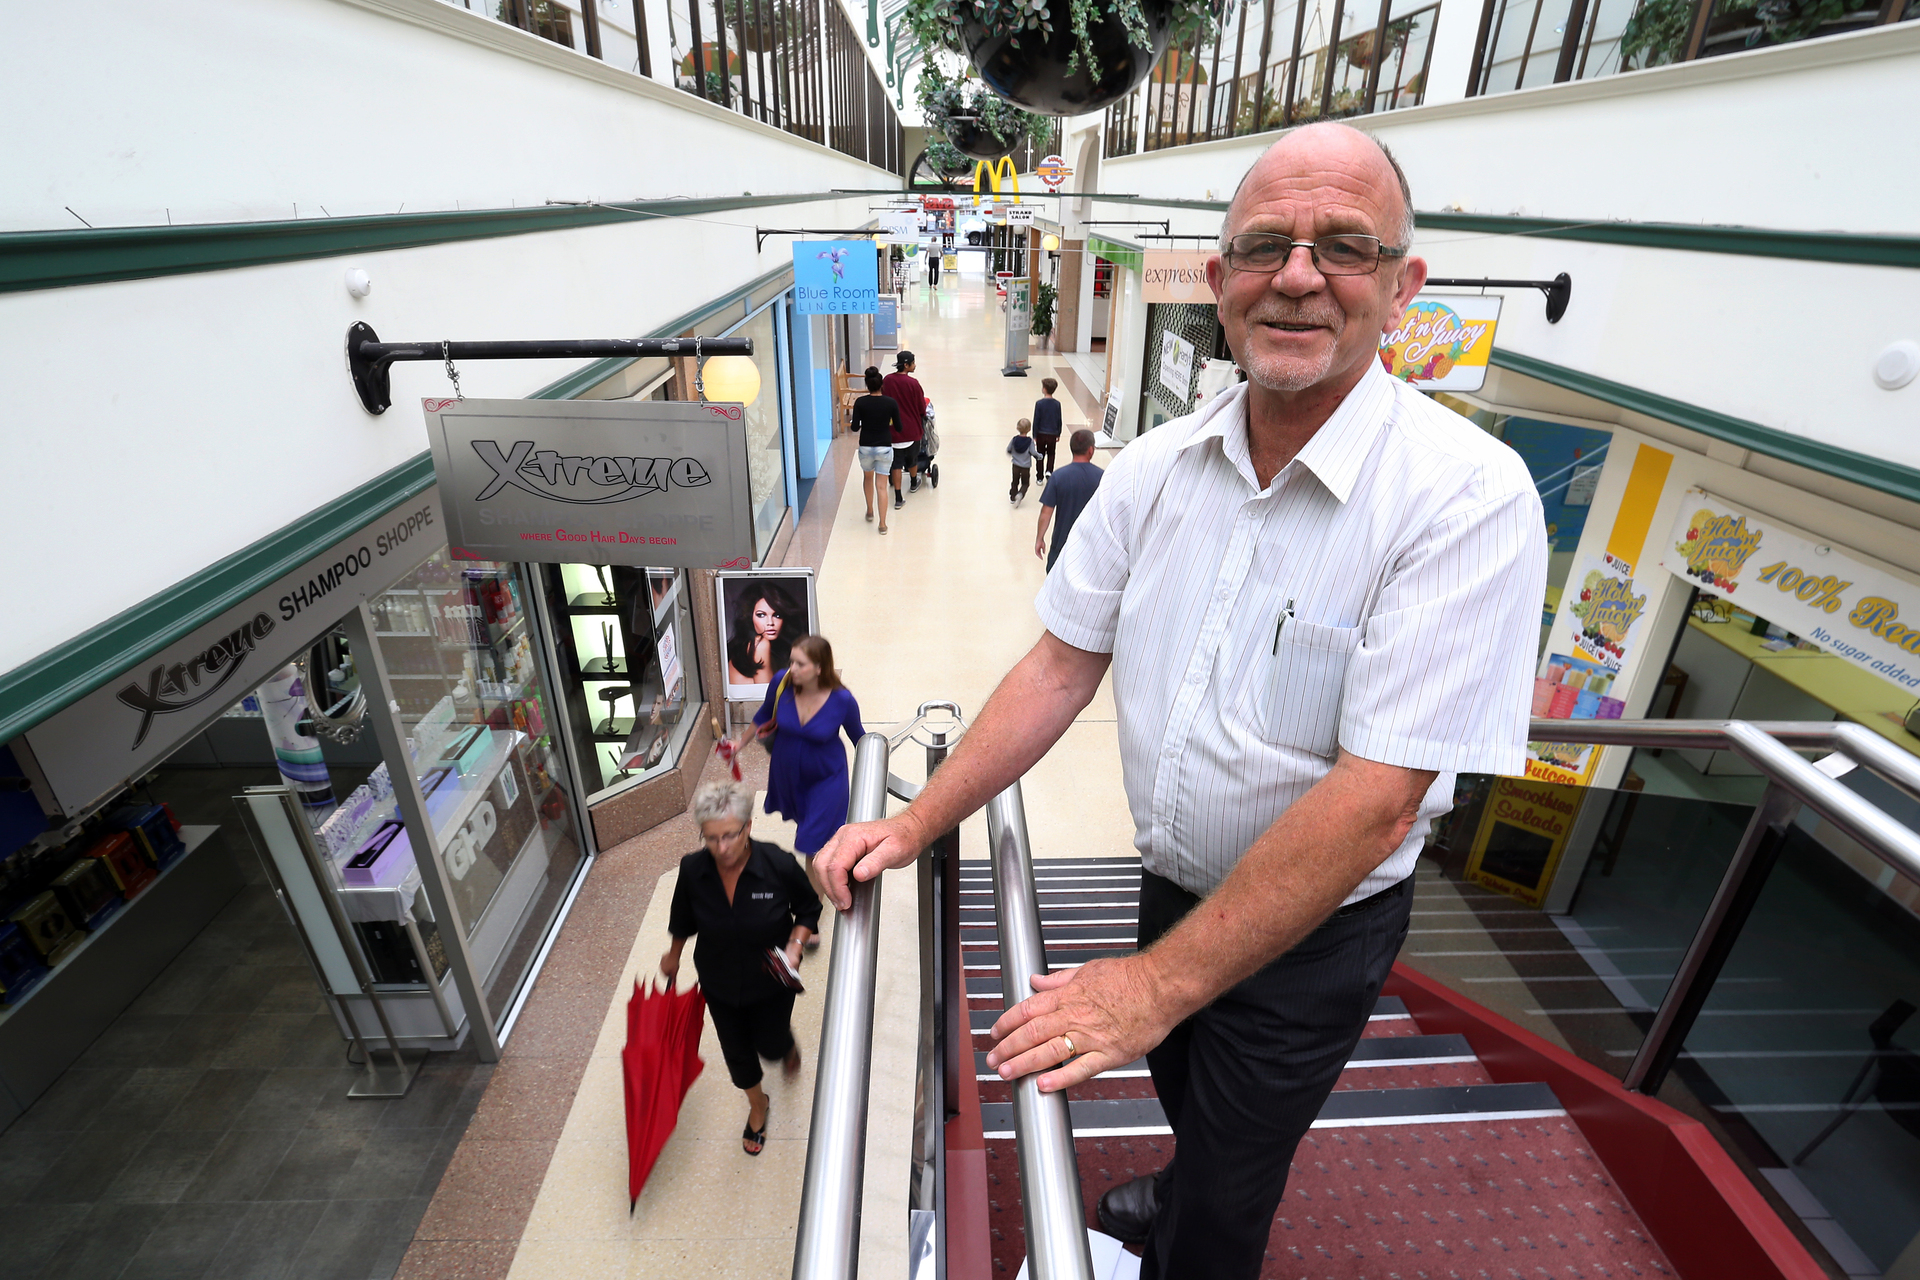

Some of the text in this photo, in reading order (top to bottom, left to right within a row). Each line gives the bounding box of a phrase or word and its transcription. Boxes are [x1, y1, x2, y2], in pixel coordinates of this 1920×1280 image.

[798, 286, 876, 299] Blue Room
[799, 302, 876, 311] LINGERIE
[1404, 312, 1487, 363] Juicy
[279, 546, 371, 622] SHAMPOO
[376, 505, 433, 556] SHOPPE
[1611, 558, 1630, 576] JUICE
[1687, 538, 1761, 570] Juicy
[1756, 561, 1853, 614] 100%
[1582, 600, 1644, 634] Juicy
[1579, 638, 1597, 656] JUICE
[1603, 656, 1622, 674] JUICE
[1810, 627, 1920, 688] No sugar added
[1498, 778, 1574, 816] Smoothies
[1494, 799, 1563, 835] Salads
[445, 801, 497, 881] GHD
